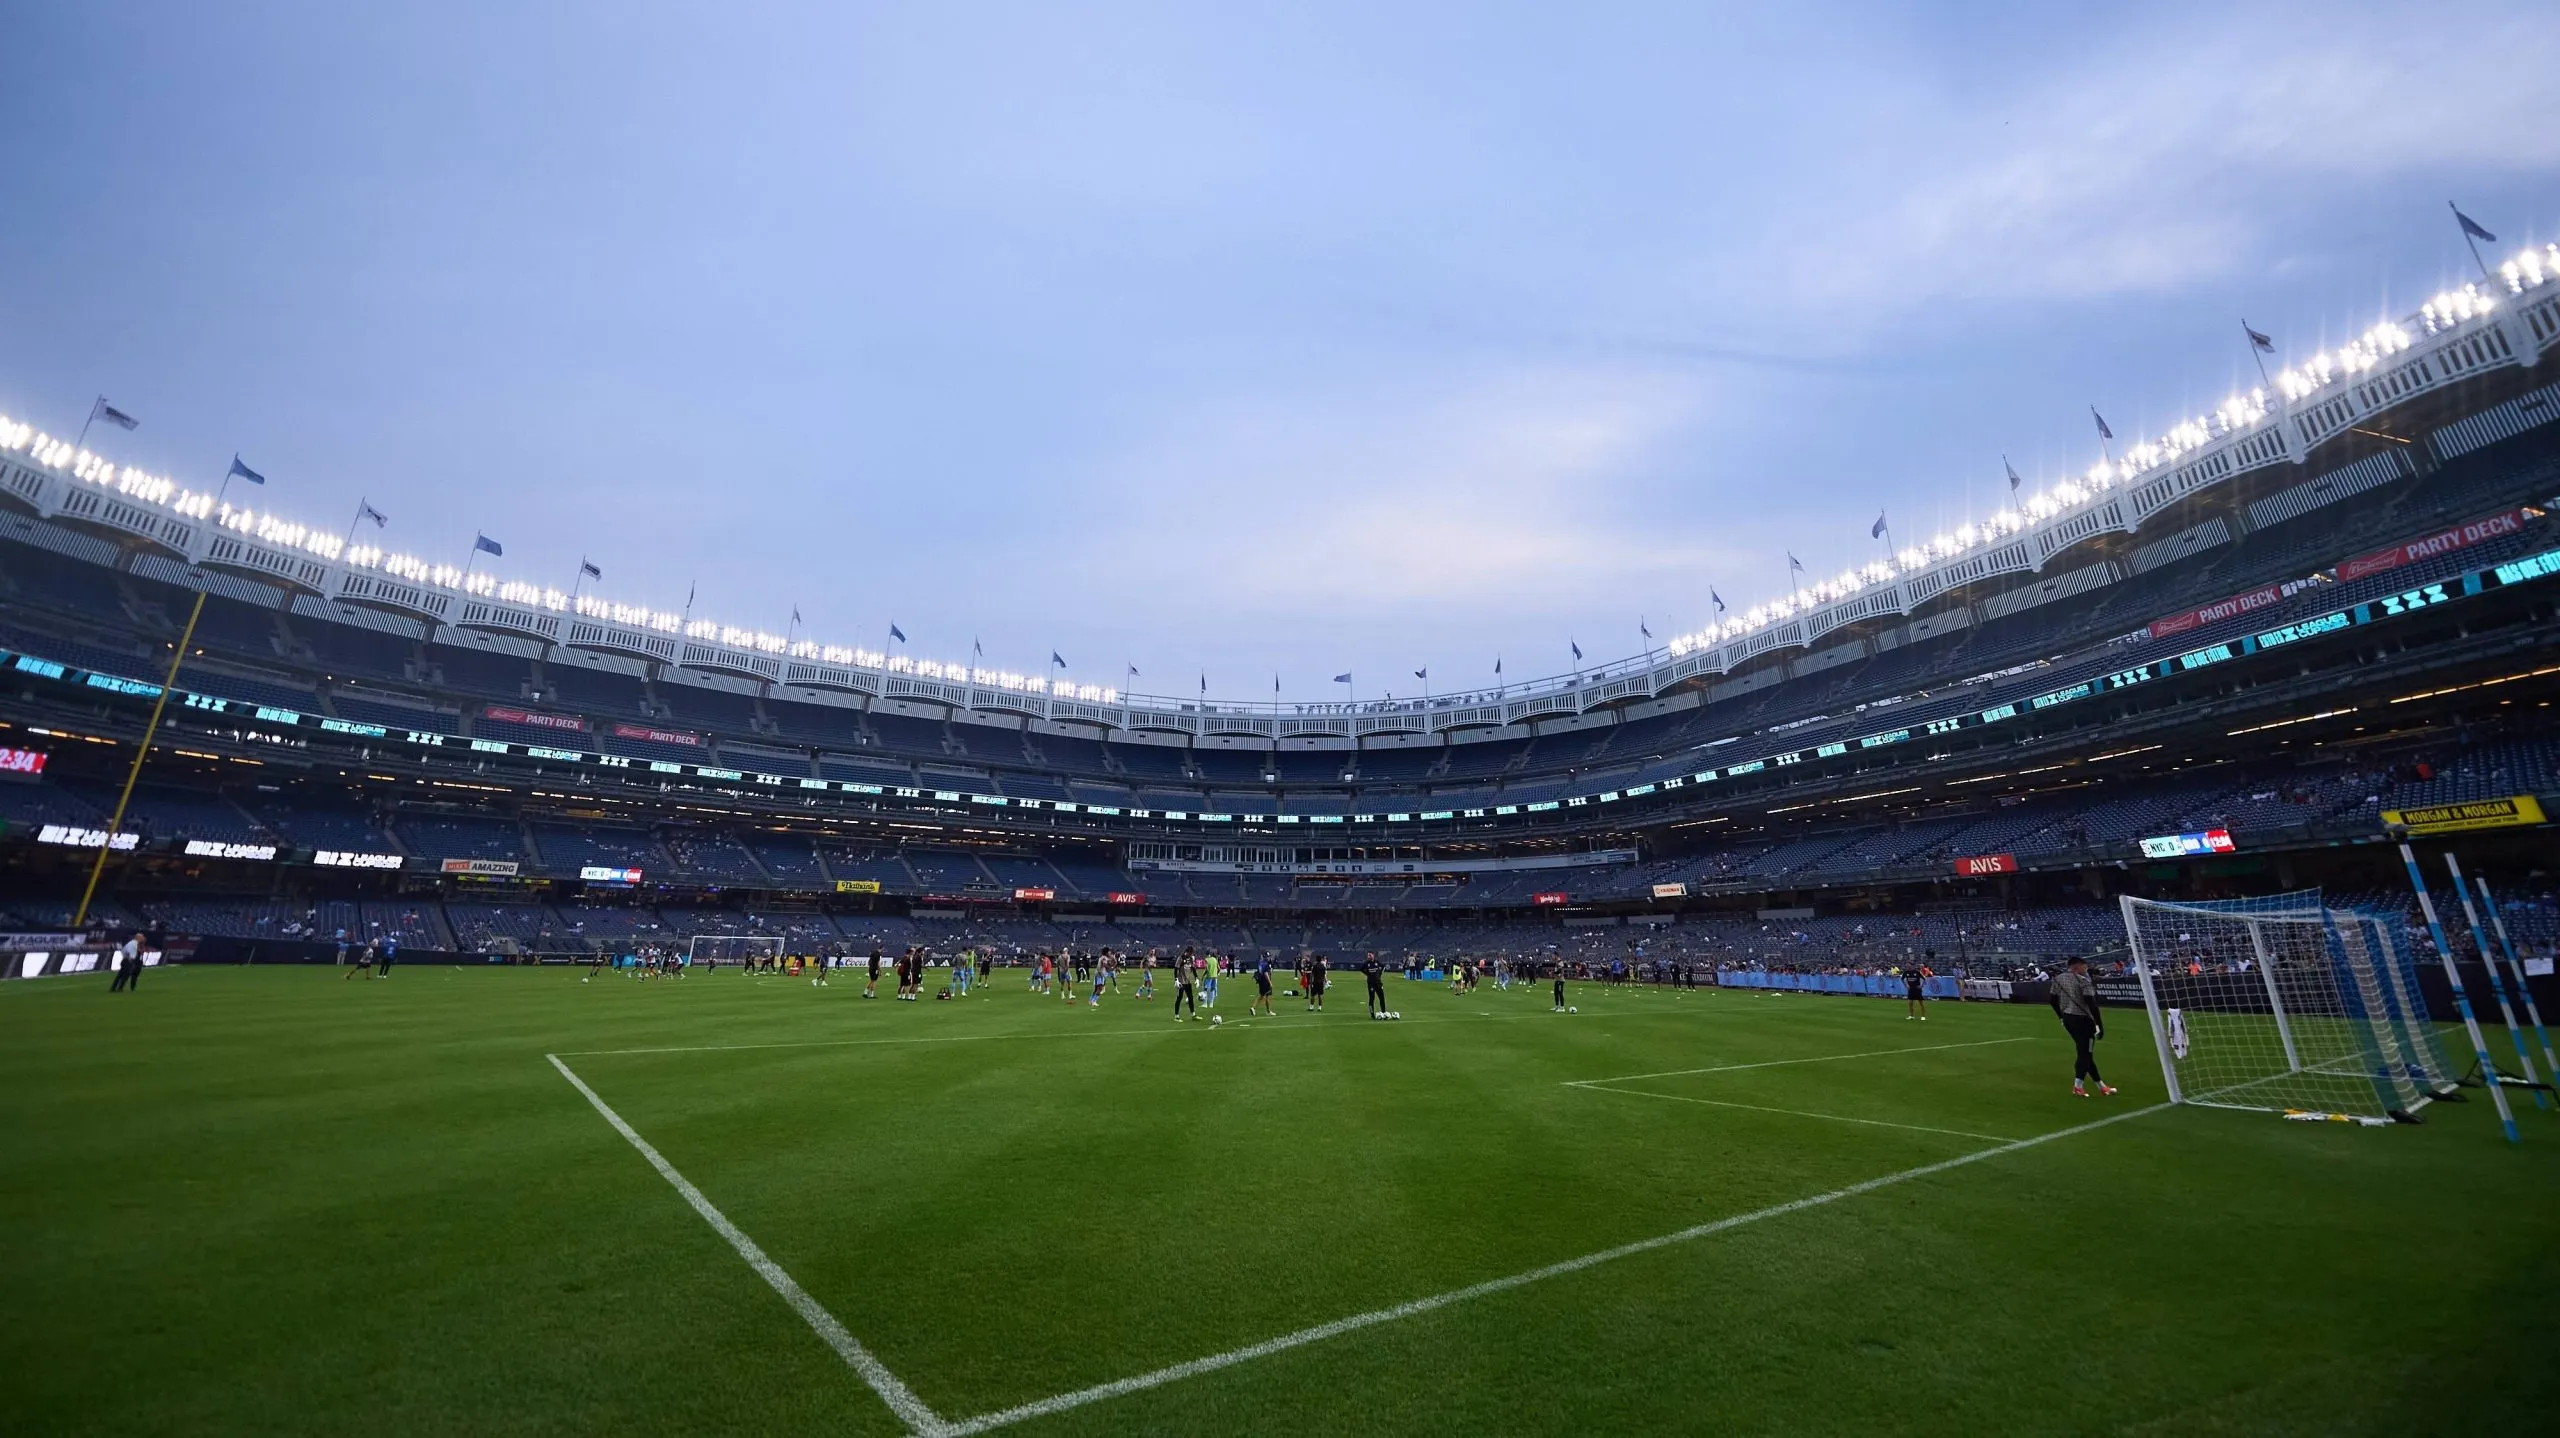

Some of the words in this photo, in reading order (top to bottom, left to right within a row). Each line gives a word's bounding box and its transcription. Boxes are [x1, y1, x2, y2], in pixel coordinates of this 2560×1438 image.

[2406, 530, 2460, 560] PARTY
[2464, 513, 2517, 541] DECK
[2199, 601, 2237, 623] PARTY
[2240, 588, 2277, 610] DECK
[2295, 612, 2347, 631] LEAGUES
[2298, 627, 2321, 638] CUP
[2056, 684, 2089, 697] LEAGUES
[2059, 694, 2073, 702] CUP
[526, 714, 553, 726] PARTY
[556, 718, 580, 729] DECK
[650, 731, 674, 742] PARTY
[676, 734, 697, 745] DECK
[2406, 808, 2451, 824] MORGAN
[2453, 806, 2462, 819] &
[2464, 801, 2512, 818] MORGAN
[2150, 842, 2166, 853] NYC
[2168, 841, 2175, 851] 0
[472, 863, 515, 873] AMAZING
[1970, 857, 2002, 873] AVIS
[1116, 894, 1136, 903] AVIS
[10, 935, 68, 945] LEAGUES
[845, 957, 868, 967] Coors
